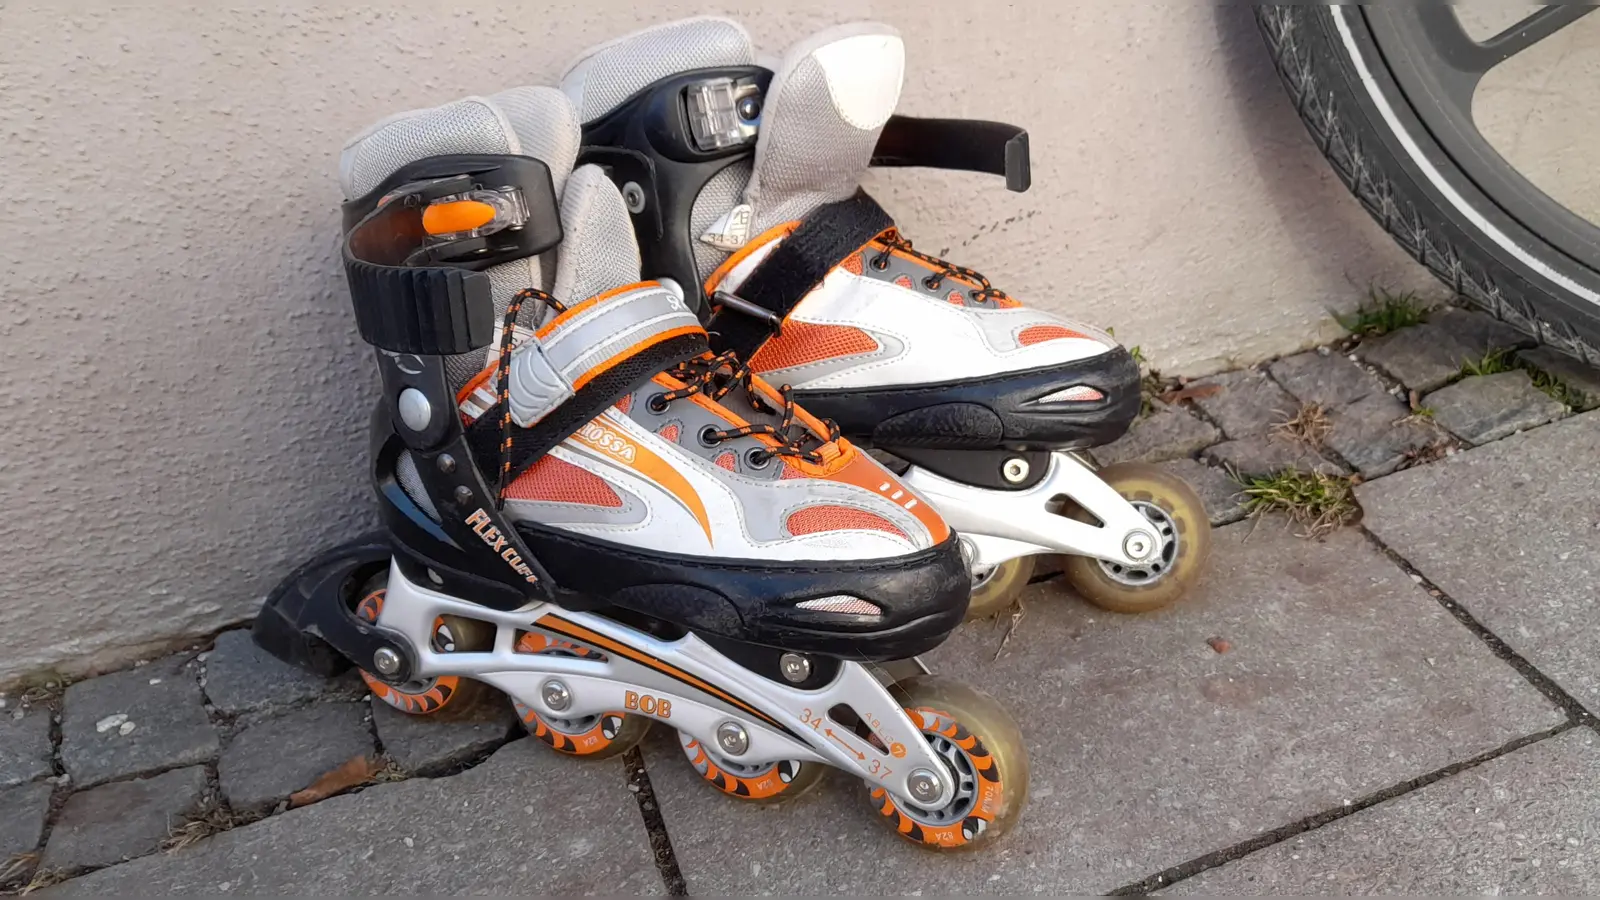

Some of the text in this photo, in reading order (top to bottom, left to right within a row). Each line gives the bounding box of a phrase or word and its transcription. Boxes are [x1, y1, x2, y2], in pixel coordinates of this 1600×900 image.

[708, 233, 745, 245] 34-37
[577, 421, 635, 462] ROSSA
[464, 507, 538, 584] FLEX CUFF
[625, 690, 671, 718] BOB
[800, 708, 892, 779] 34 37
